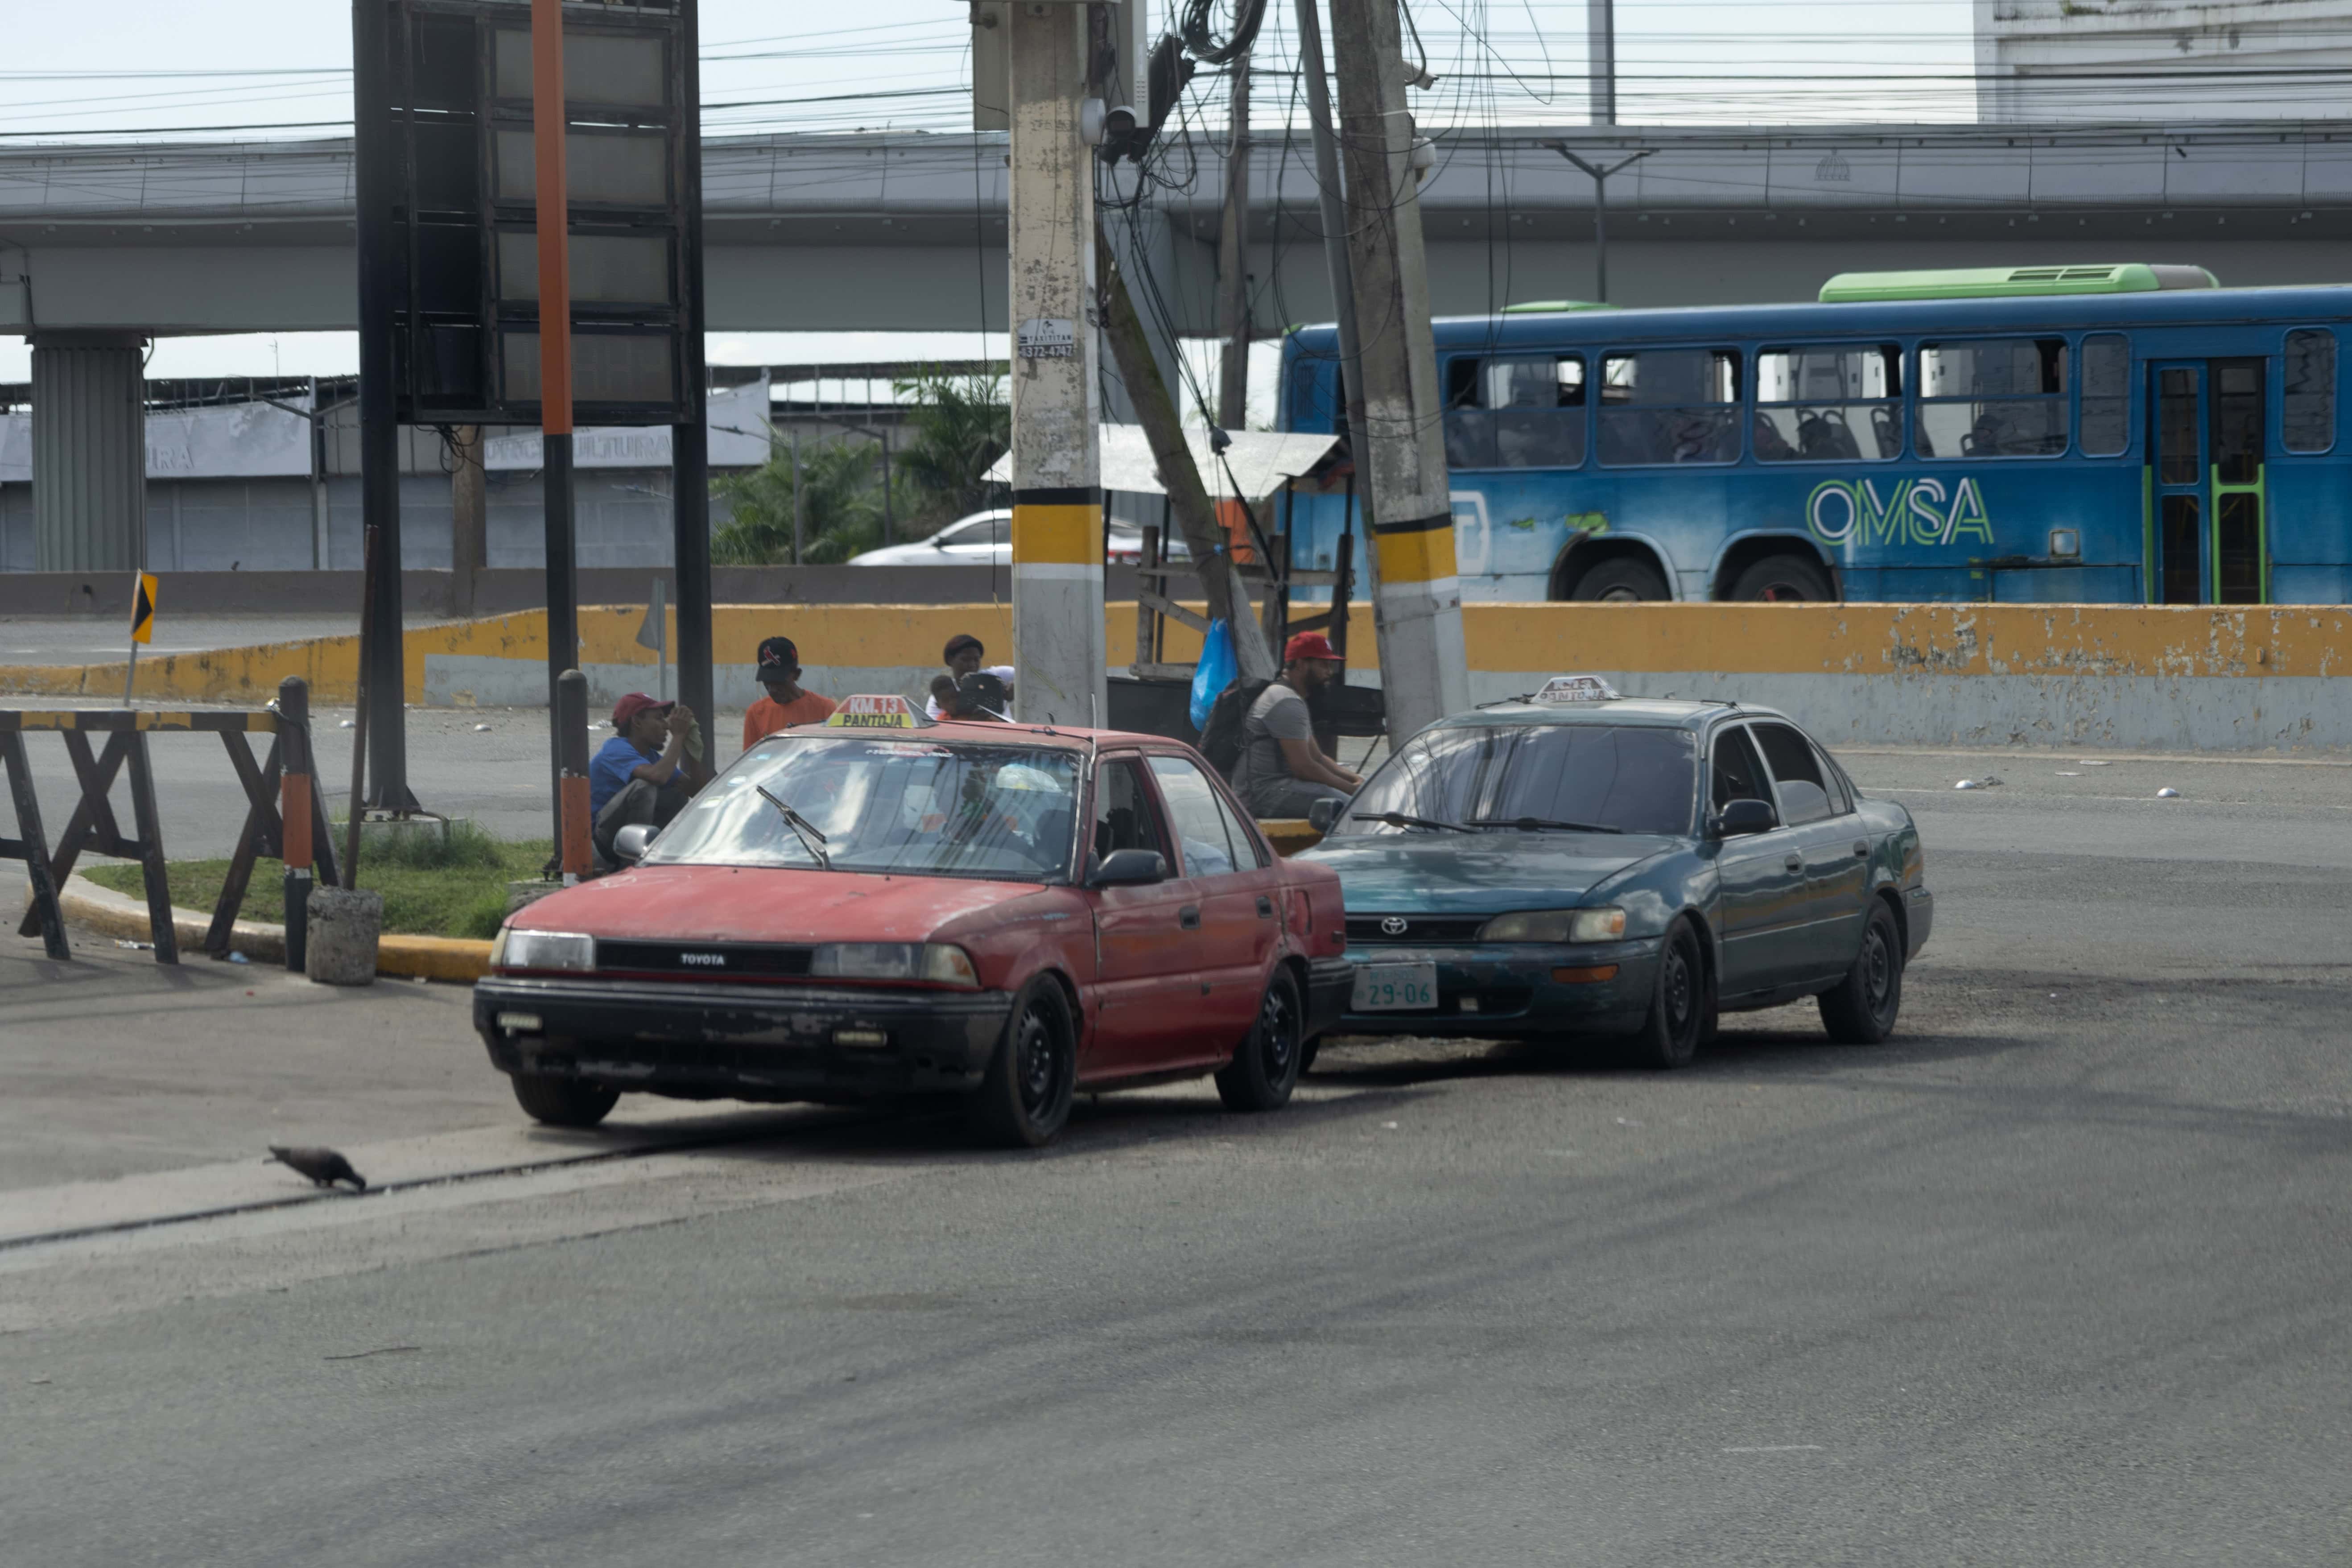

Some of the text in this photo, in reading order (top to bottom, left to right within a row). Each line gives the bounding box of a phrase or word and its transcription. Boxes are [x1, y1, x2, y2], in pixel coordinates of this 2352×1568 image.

[1806, 478, 1995, 546] OMSA
[843, 714, 902, 727] PANTOJA
[681, 953, 725, 965] TOYOTA
[1369, 982, 1431, 1005] 29-06
